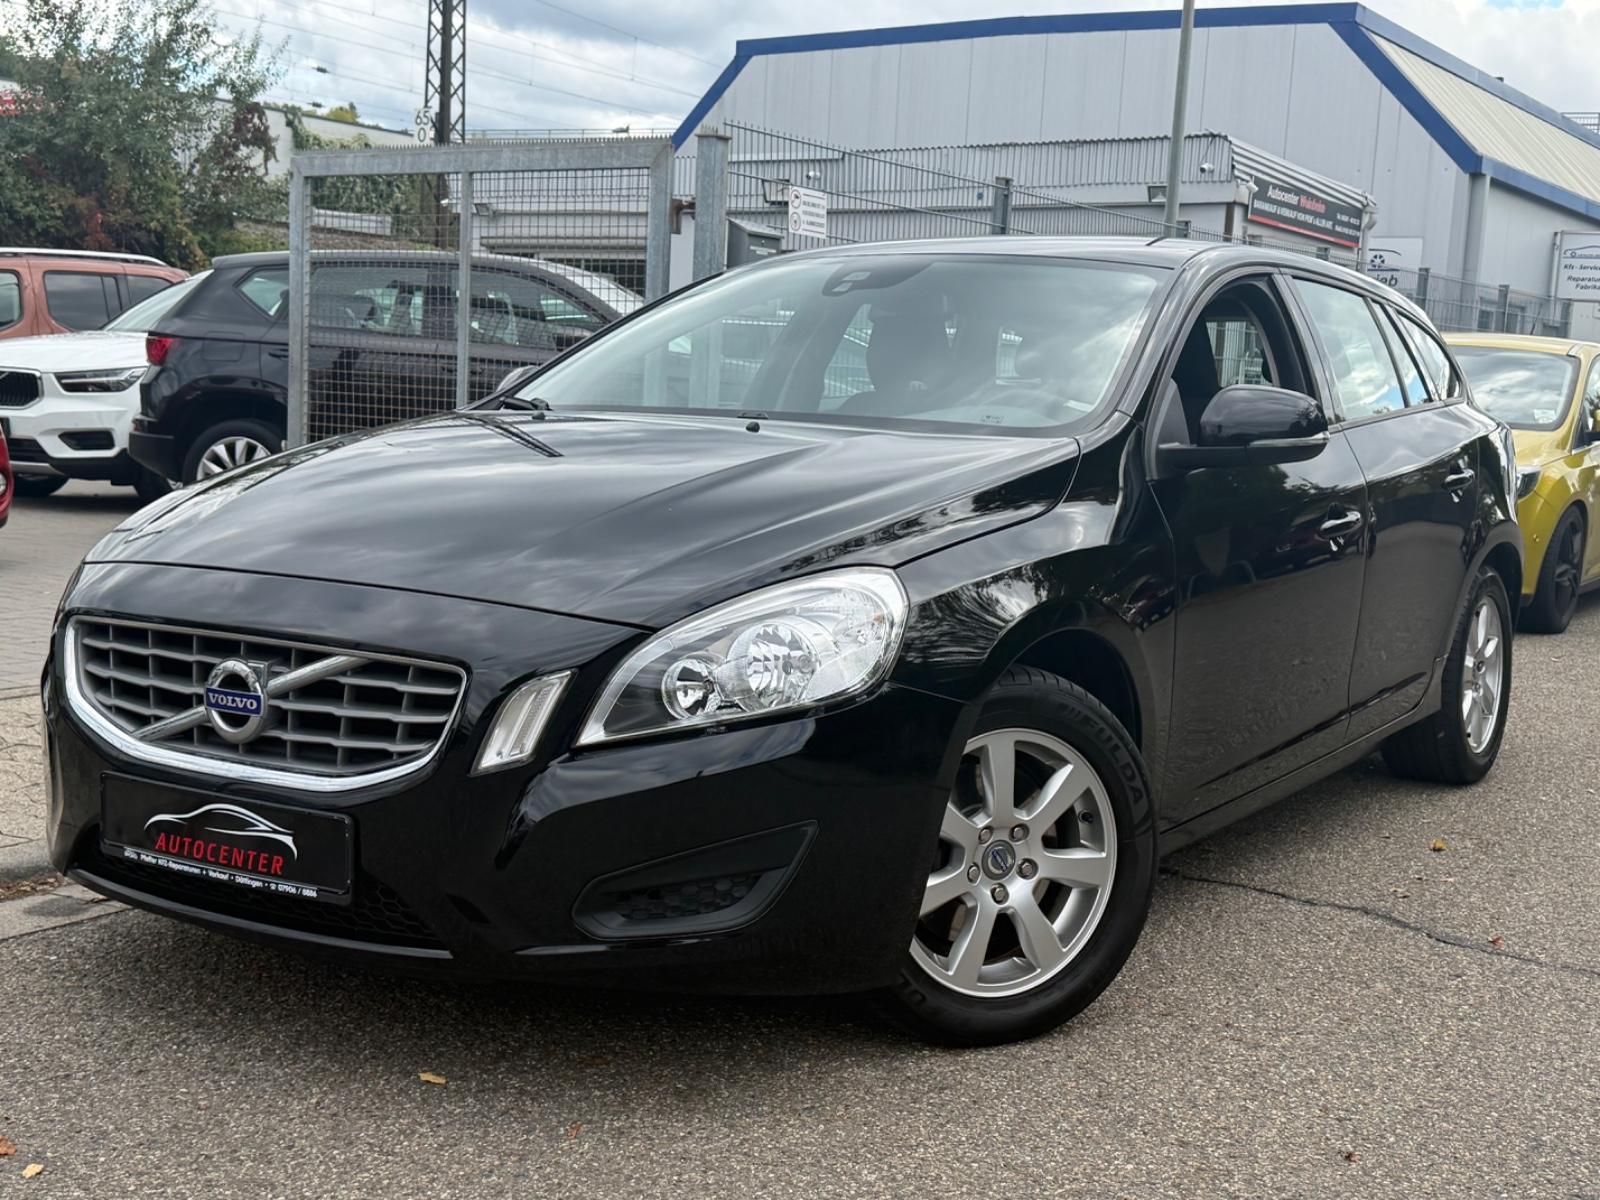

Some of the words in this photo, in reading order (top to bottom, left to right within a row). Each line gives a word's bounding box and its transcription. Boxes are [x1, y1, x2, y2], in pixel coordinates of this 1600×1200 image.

[415, 110, 430, 126] 65
[208, 692, 258, 710] VOLVO
[1080, 713, 1144, 807] FULDA
[155, 832, 285, 876] AUTOCENTER
